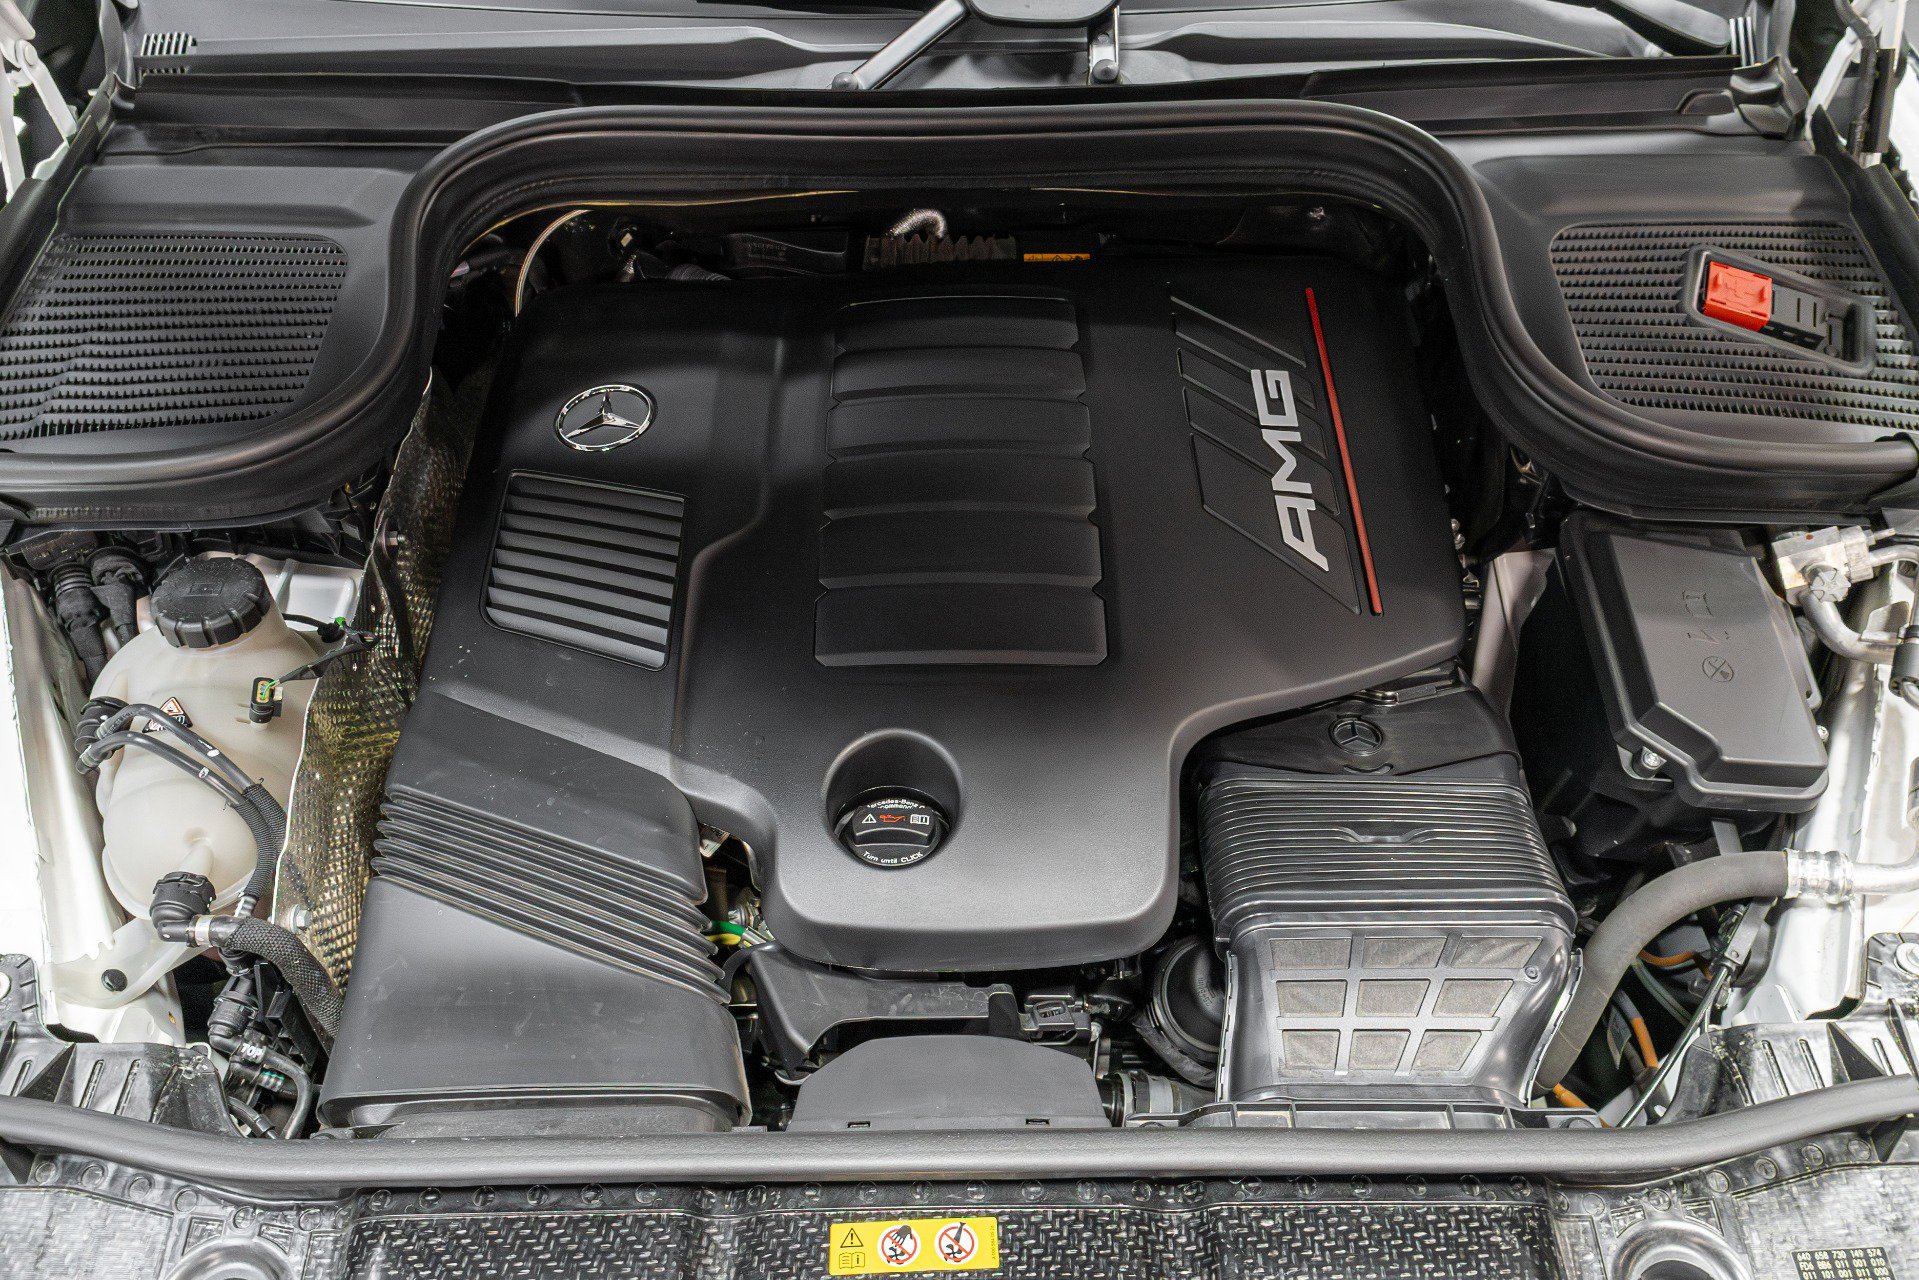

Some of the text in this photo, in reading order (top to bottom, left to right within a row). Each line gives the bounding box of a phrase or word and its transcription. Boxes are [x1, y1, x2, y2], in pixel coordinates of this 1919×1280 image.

[1250, 369, 1330, 572] AMG
[863, 850, 879, 861] Turn
[900, 851, 923, 863] CLICK
[240, 1042, 264, 1059] TOP
[1797, 1248, 1882, 1261] 640 658 730 149 574
[1799, 1261, 1814, 1271] FD6
[1834, 1259, 1849, 1269] 011
[1852, 1258, 1867, 1268] 001
[1870, 1258, 1885, 1267] 010
[1802, 1271, 1817, 1280] 011
[1820, 1270, 1835, 1279] 101
[1837, 1269, 1852, 1278] 001
[1855, 1269, 1871, 1278] 011
[1873, 1267, 1889, 1277] 000
